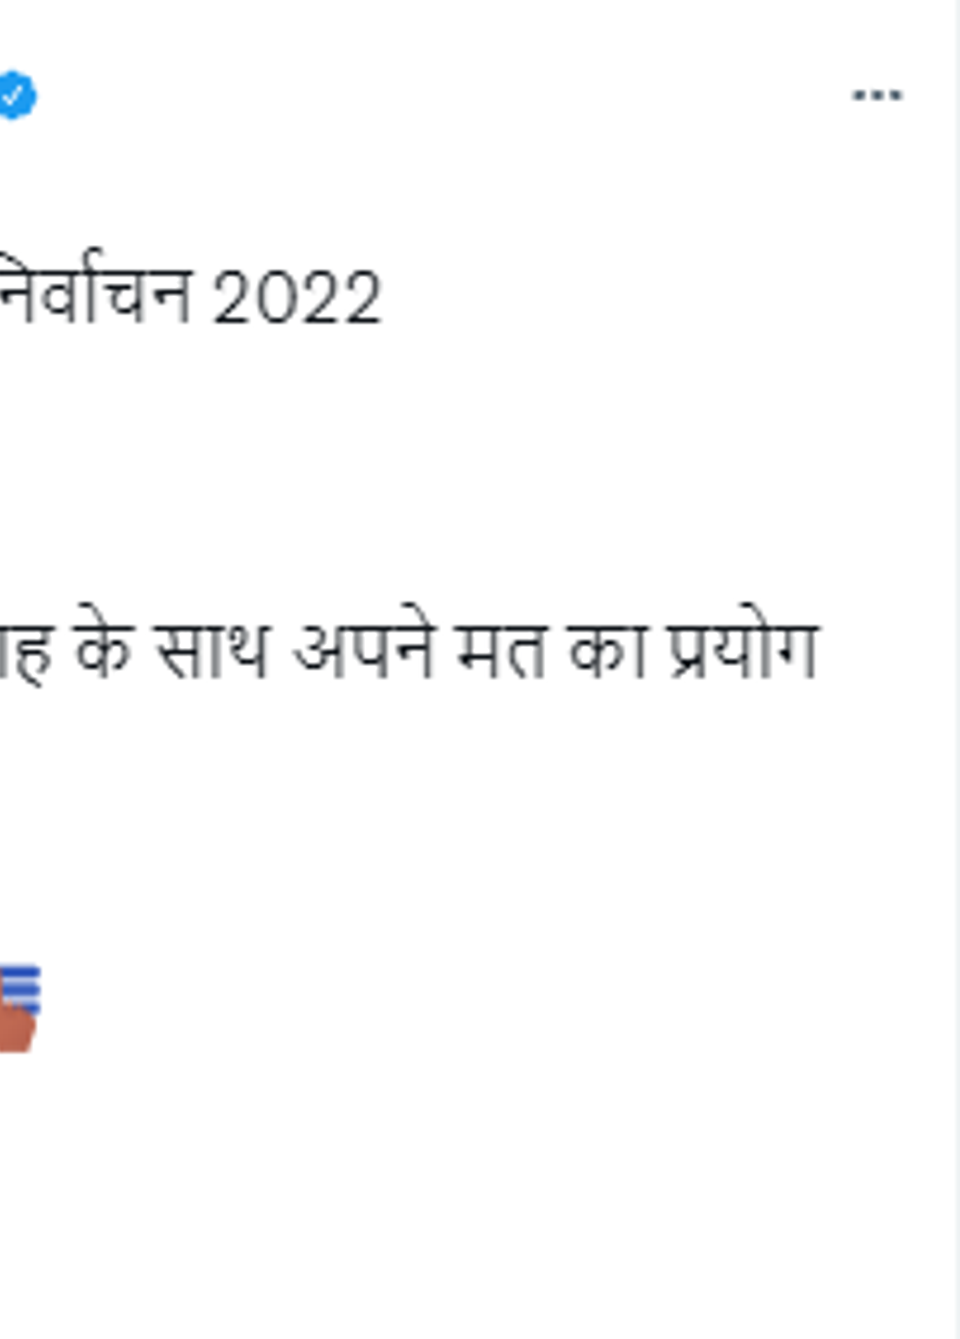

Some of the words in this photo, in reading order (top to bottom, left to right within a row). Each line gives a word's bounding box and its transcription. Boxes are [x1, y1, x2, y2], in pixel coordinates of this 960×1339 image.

[214, 270, 380, 324] 2022
[71, 602, 136, 678] के
[152, 625, 272, 679] साथ
[293, 602, 438, 678] अपने
[453, 625, 550, 678] मत
[565, 625, 651, 678] का
[665, 601, 821, 678] प्रयोग
